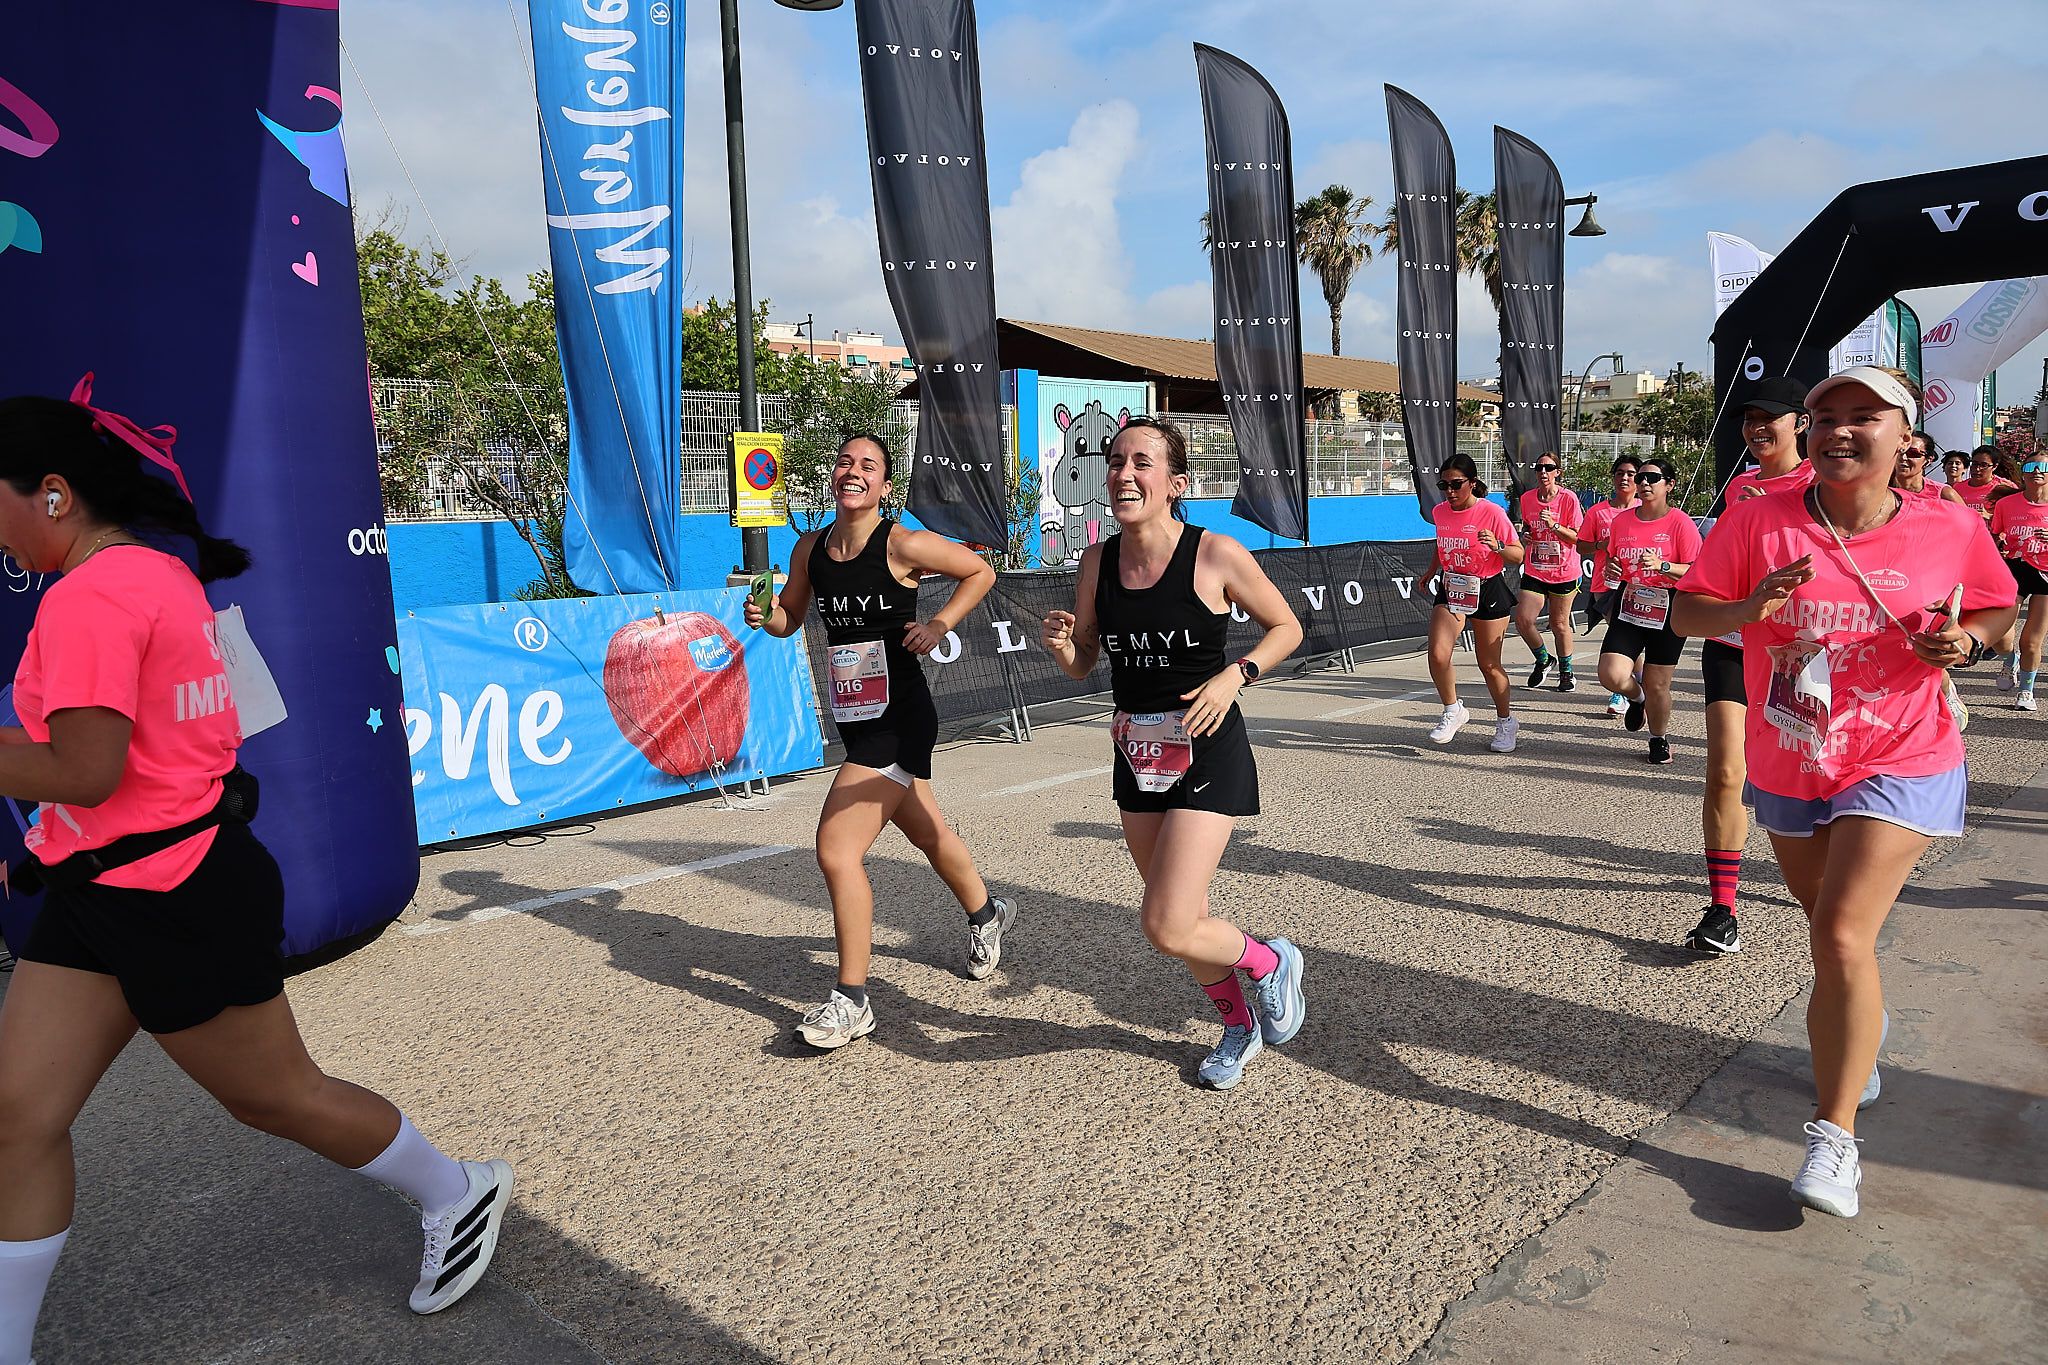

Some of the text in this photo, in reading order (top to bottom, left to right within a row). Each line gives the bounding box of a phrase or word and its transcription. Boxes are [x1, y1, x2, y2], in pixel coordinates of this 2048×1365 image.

[1436, 536, 1470, 550] CARRERA
[818, 594, 892, 612] EMYL
[1448, 591, 1466, 600] 016
[1634, 603, 1652, 613] 016
[1772, 598, 1886, 633] CARRERA
[694, 644, 728, 666] Marlene
[836, 679, 863, 694] 016
[1128, 741, 1163, 757] 016
